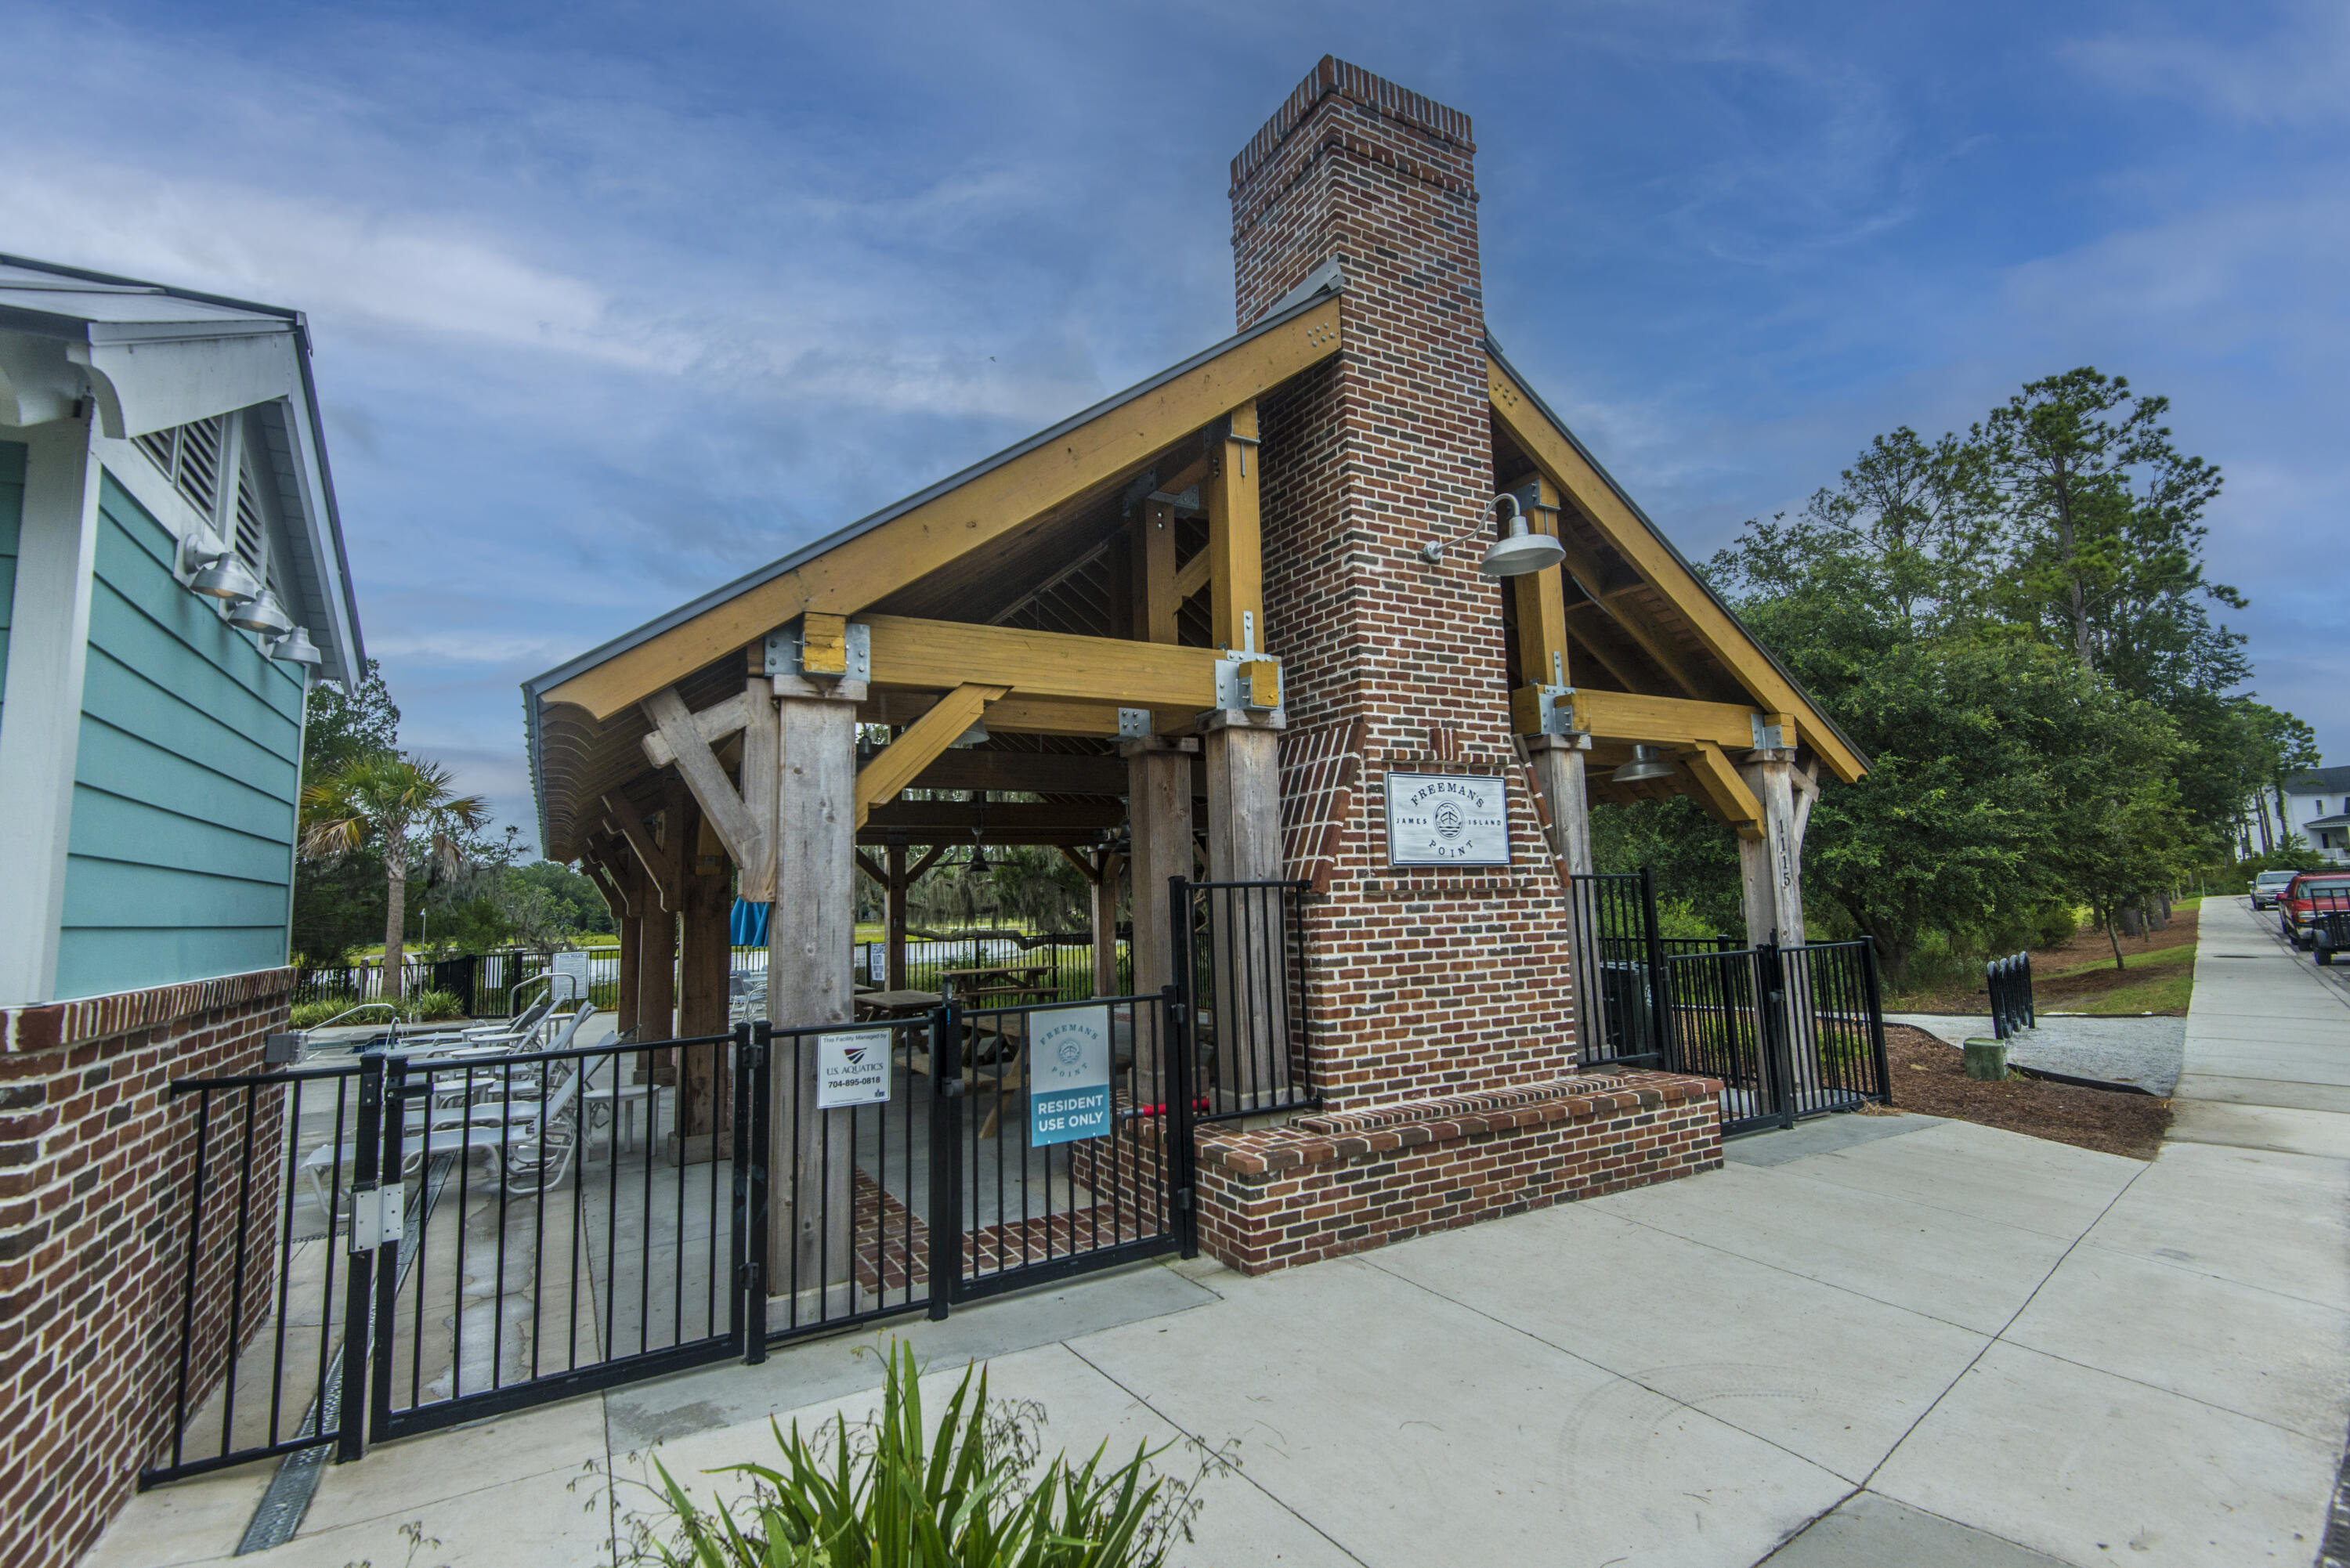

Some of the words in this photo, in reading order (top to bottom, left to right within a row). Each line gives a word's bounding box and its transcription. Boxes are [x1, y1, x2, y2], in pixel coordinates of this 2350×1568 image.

[1410, 782, 1484, 808] FREEMAN'S
[1428, 839, 1473, 858] POINT
[1780, 819, 1791, 887] 1115
[1039, 1024, 1098, 1046] FREEMAN'S
[841, 1062, 884, 1075] AQUATICS
[1051, 1062, 1088, 1078] POINT
[828, 1076, 880, 1089] 704-895-0818
[1038, 1094, 1104, 1115] RESIDENT
[1039, 1116, 1065, 1133] USE
[1068, 1111, 1104, 1128] ONLY
